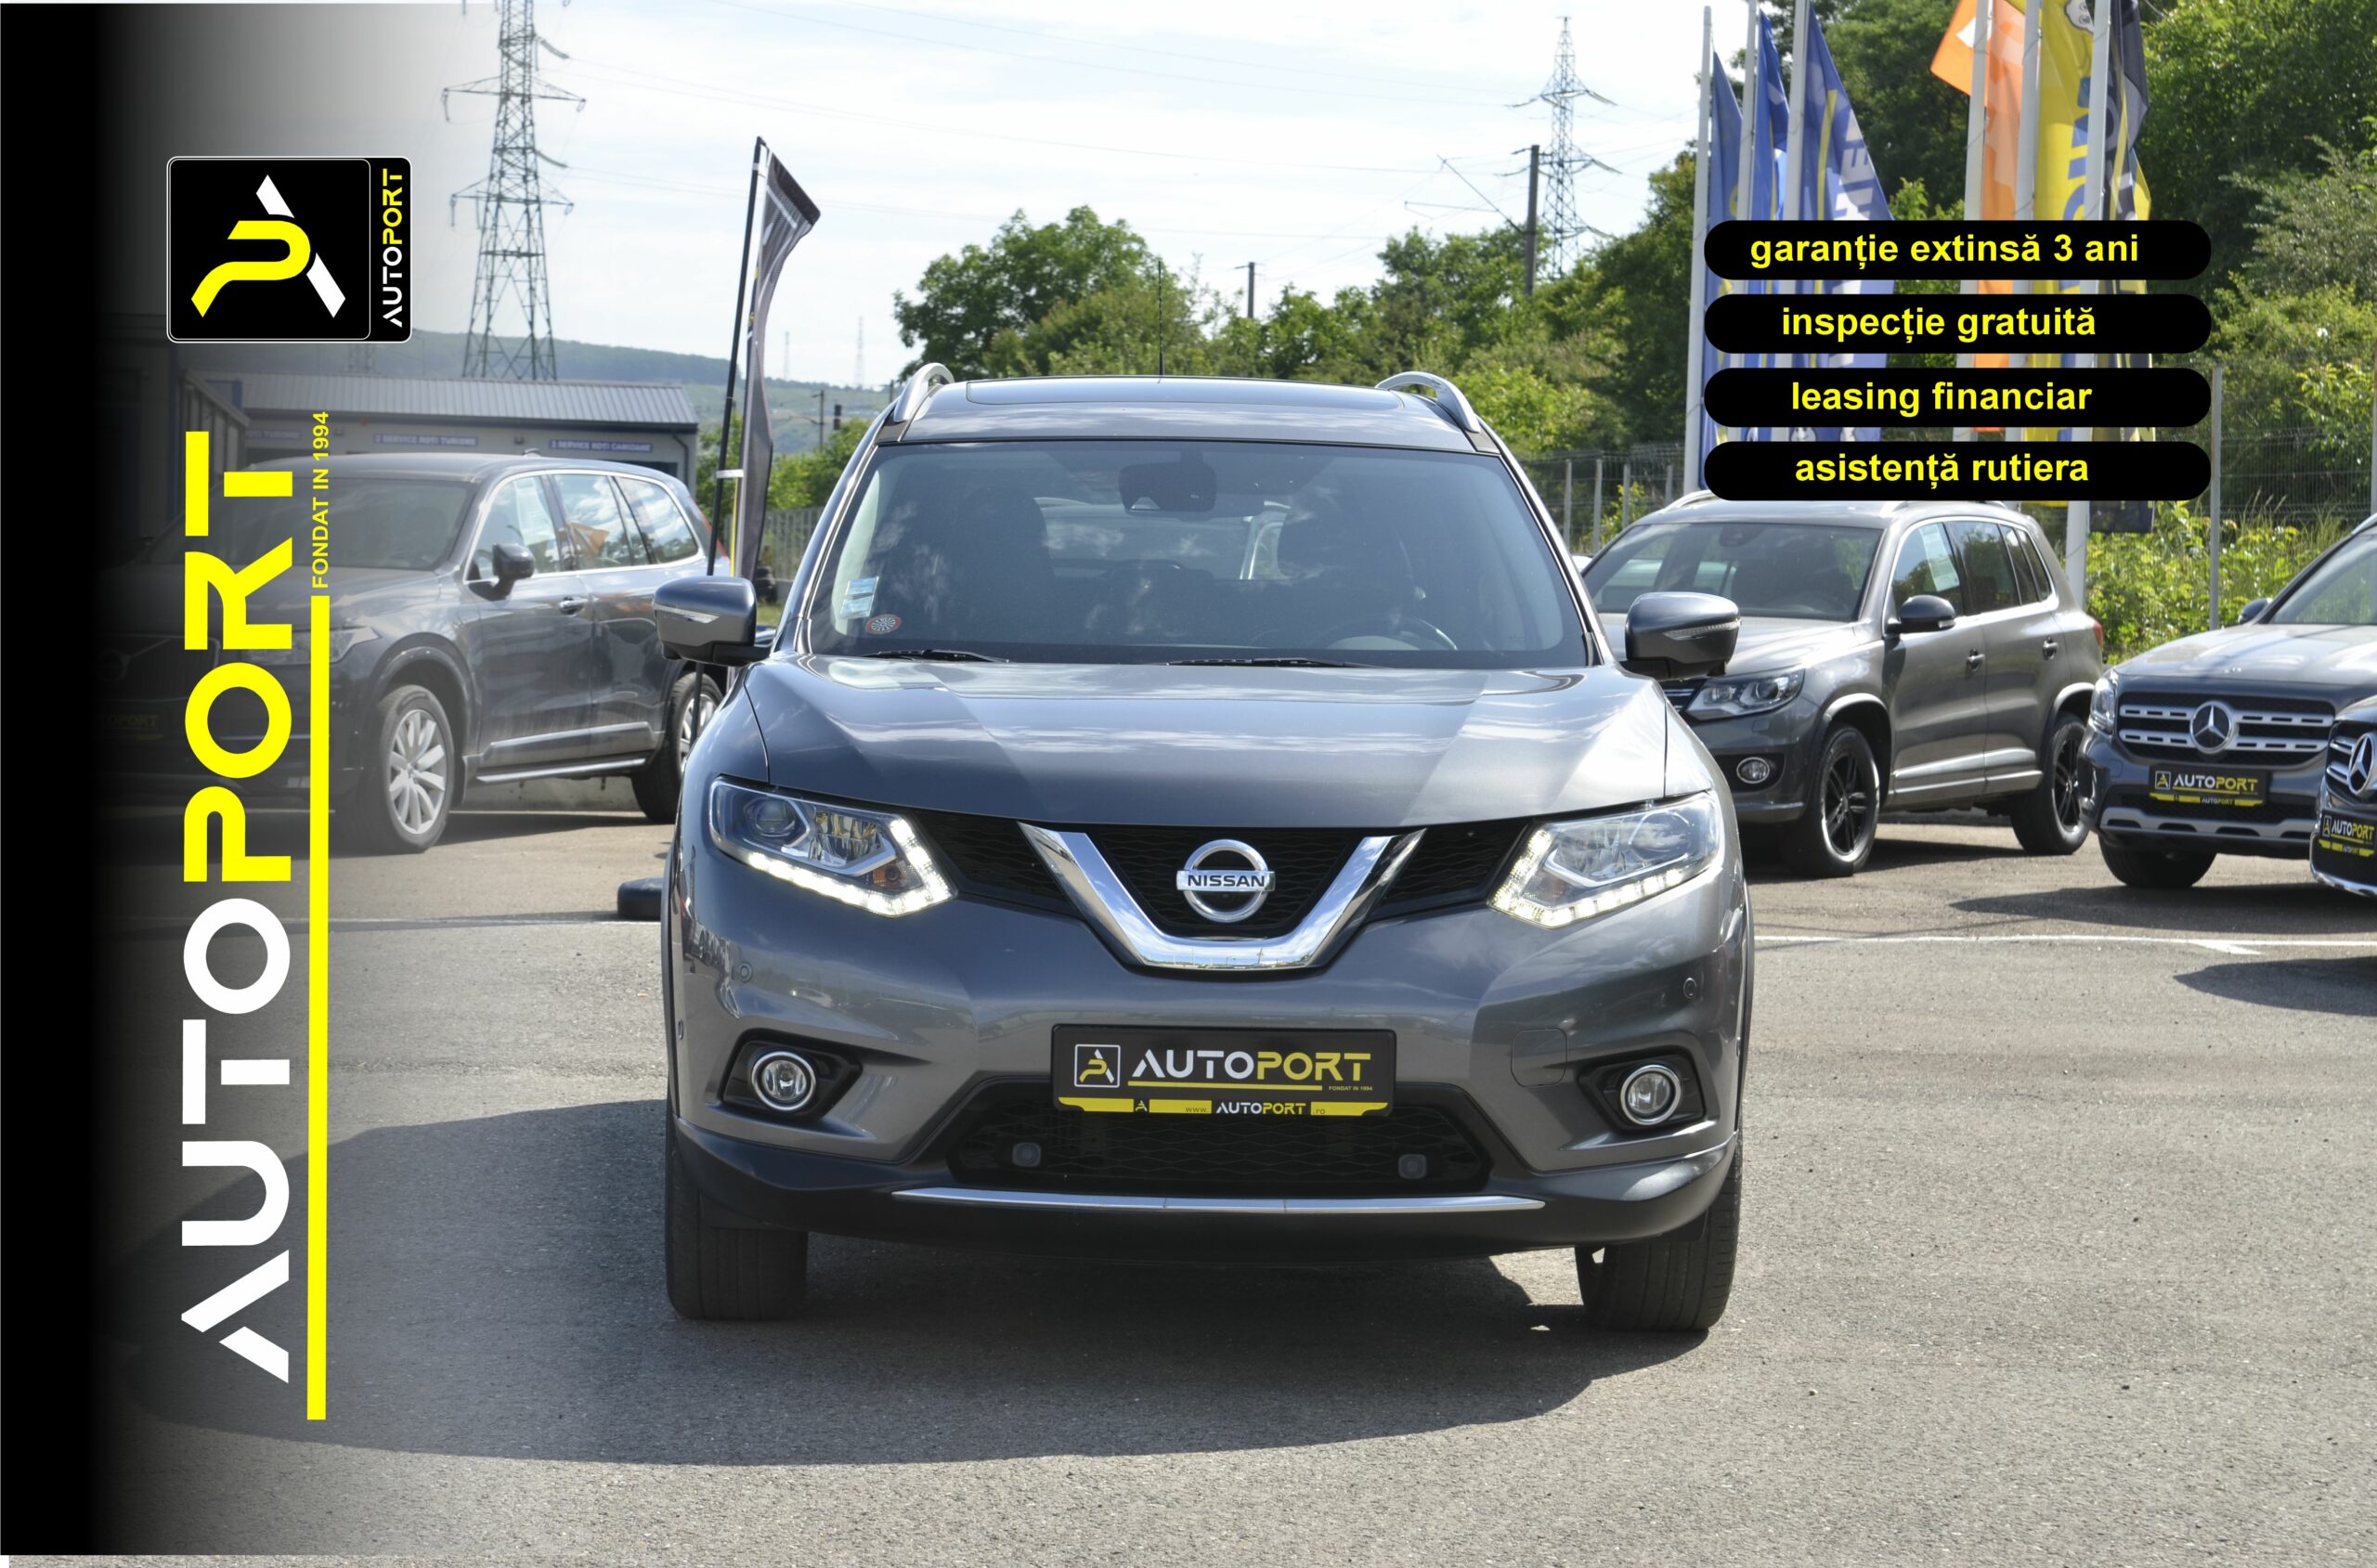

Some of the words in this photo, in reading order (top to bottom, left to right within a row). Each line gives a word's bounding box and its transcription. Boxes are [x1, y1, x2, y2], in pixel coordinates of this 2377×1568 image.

[2173, 773, 2259, 792] AUTOPORT
[2332, 818, 2375, 841] AUTOPORT
[1188, 874, 1266, 888] NISSAN
[1131, 1048, 1371, 1082] AUTOPORT
[1215, 1101, 1306, 1115] AUTOPORT
